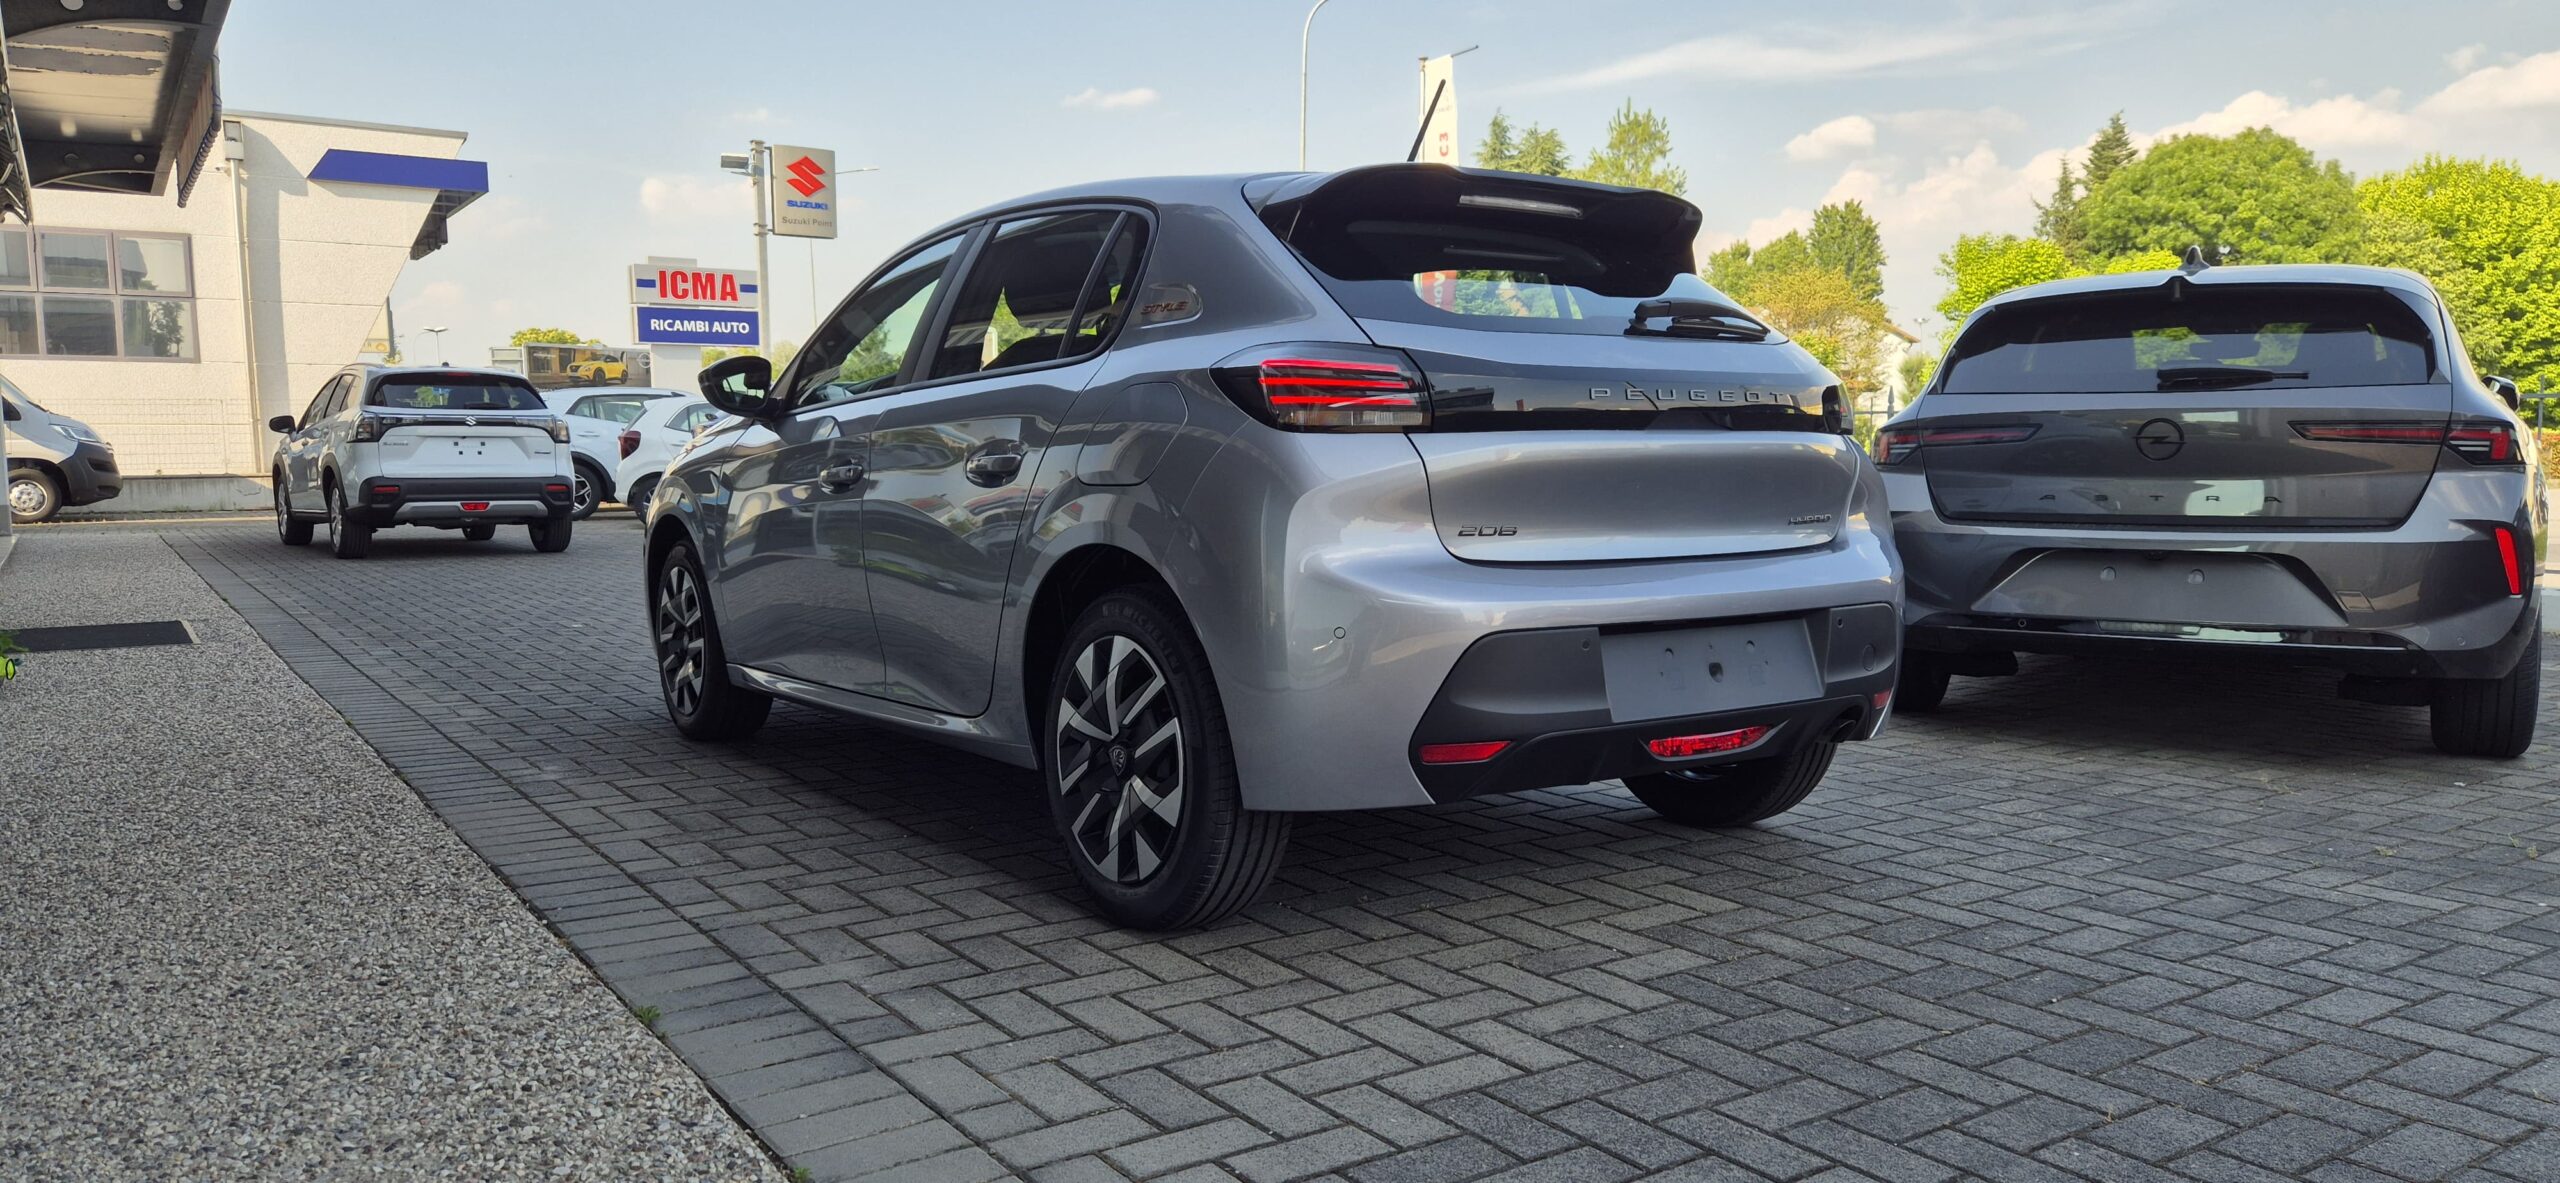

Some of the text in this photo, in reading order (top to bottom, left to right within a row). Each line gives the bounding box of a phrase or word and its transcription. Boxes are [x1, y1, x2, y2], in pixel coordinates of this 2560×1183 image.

[786, 200, 828, 210] SUZUKI
[782, 216, 833, 227] Suzuki Point
[658, 270, 739, 302] ICMA
[1141, 301, 1189, 315] STYLE
[650, 319, 750, 334] RICAMBI AUTO
[1589, 387, 1783, 403] PEUGEOT
